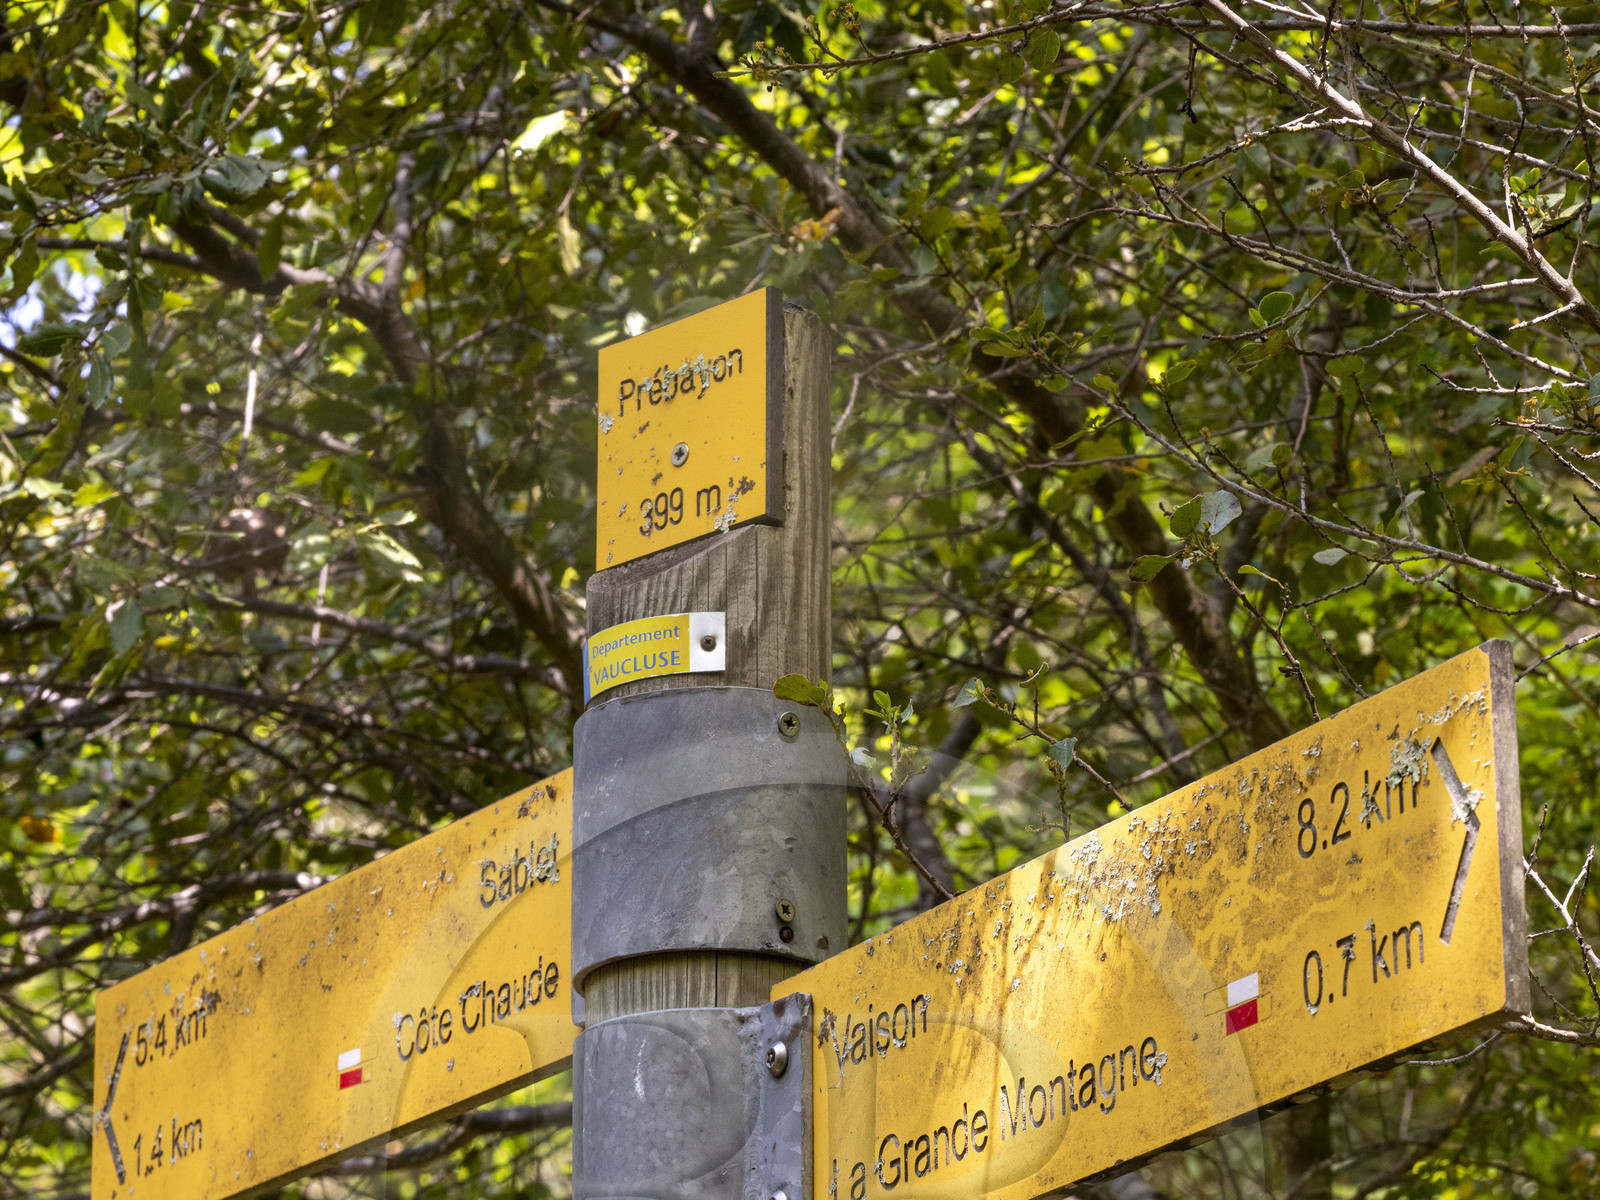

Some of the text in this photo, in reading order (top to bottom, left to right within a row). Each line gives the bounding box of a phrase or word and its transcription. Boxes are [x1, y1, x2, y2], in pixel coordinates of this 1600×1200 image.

[618, 348, 743, 417] Prébayon
[639, 484, 721, 536] 399 m
[592, 626, 681, 659] Département
[594, 650, 681, 686] VAUCLUSE
[1298, 769, 1417, 859] 8.2 km
[1303, 919, 1424, 1013] 0.7 km
[135, 1005, 207, 1067] 5.4 km
[396, 955, 559, 1062] Côte Chaude
[829, 993, 930, 1068] Vaison
[134, 1115, 202, 1177] 1.4 km
[876, 1101, 989, 1191] Grande
[1000, 1036, 1160, 1141] Montagne
